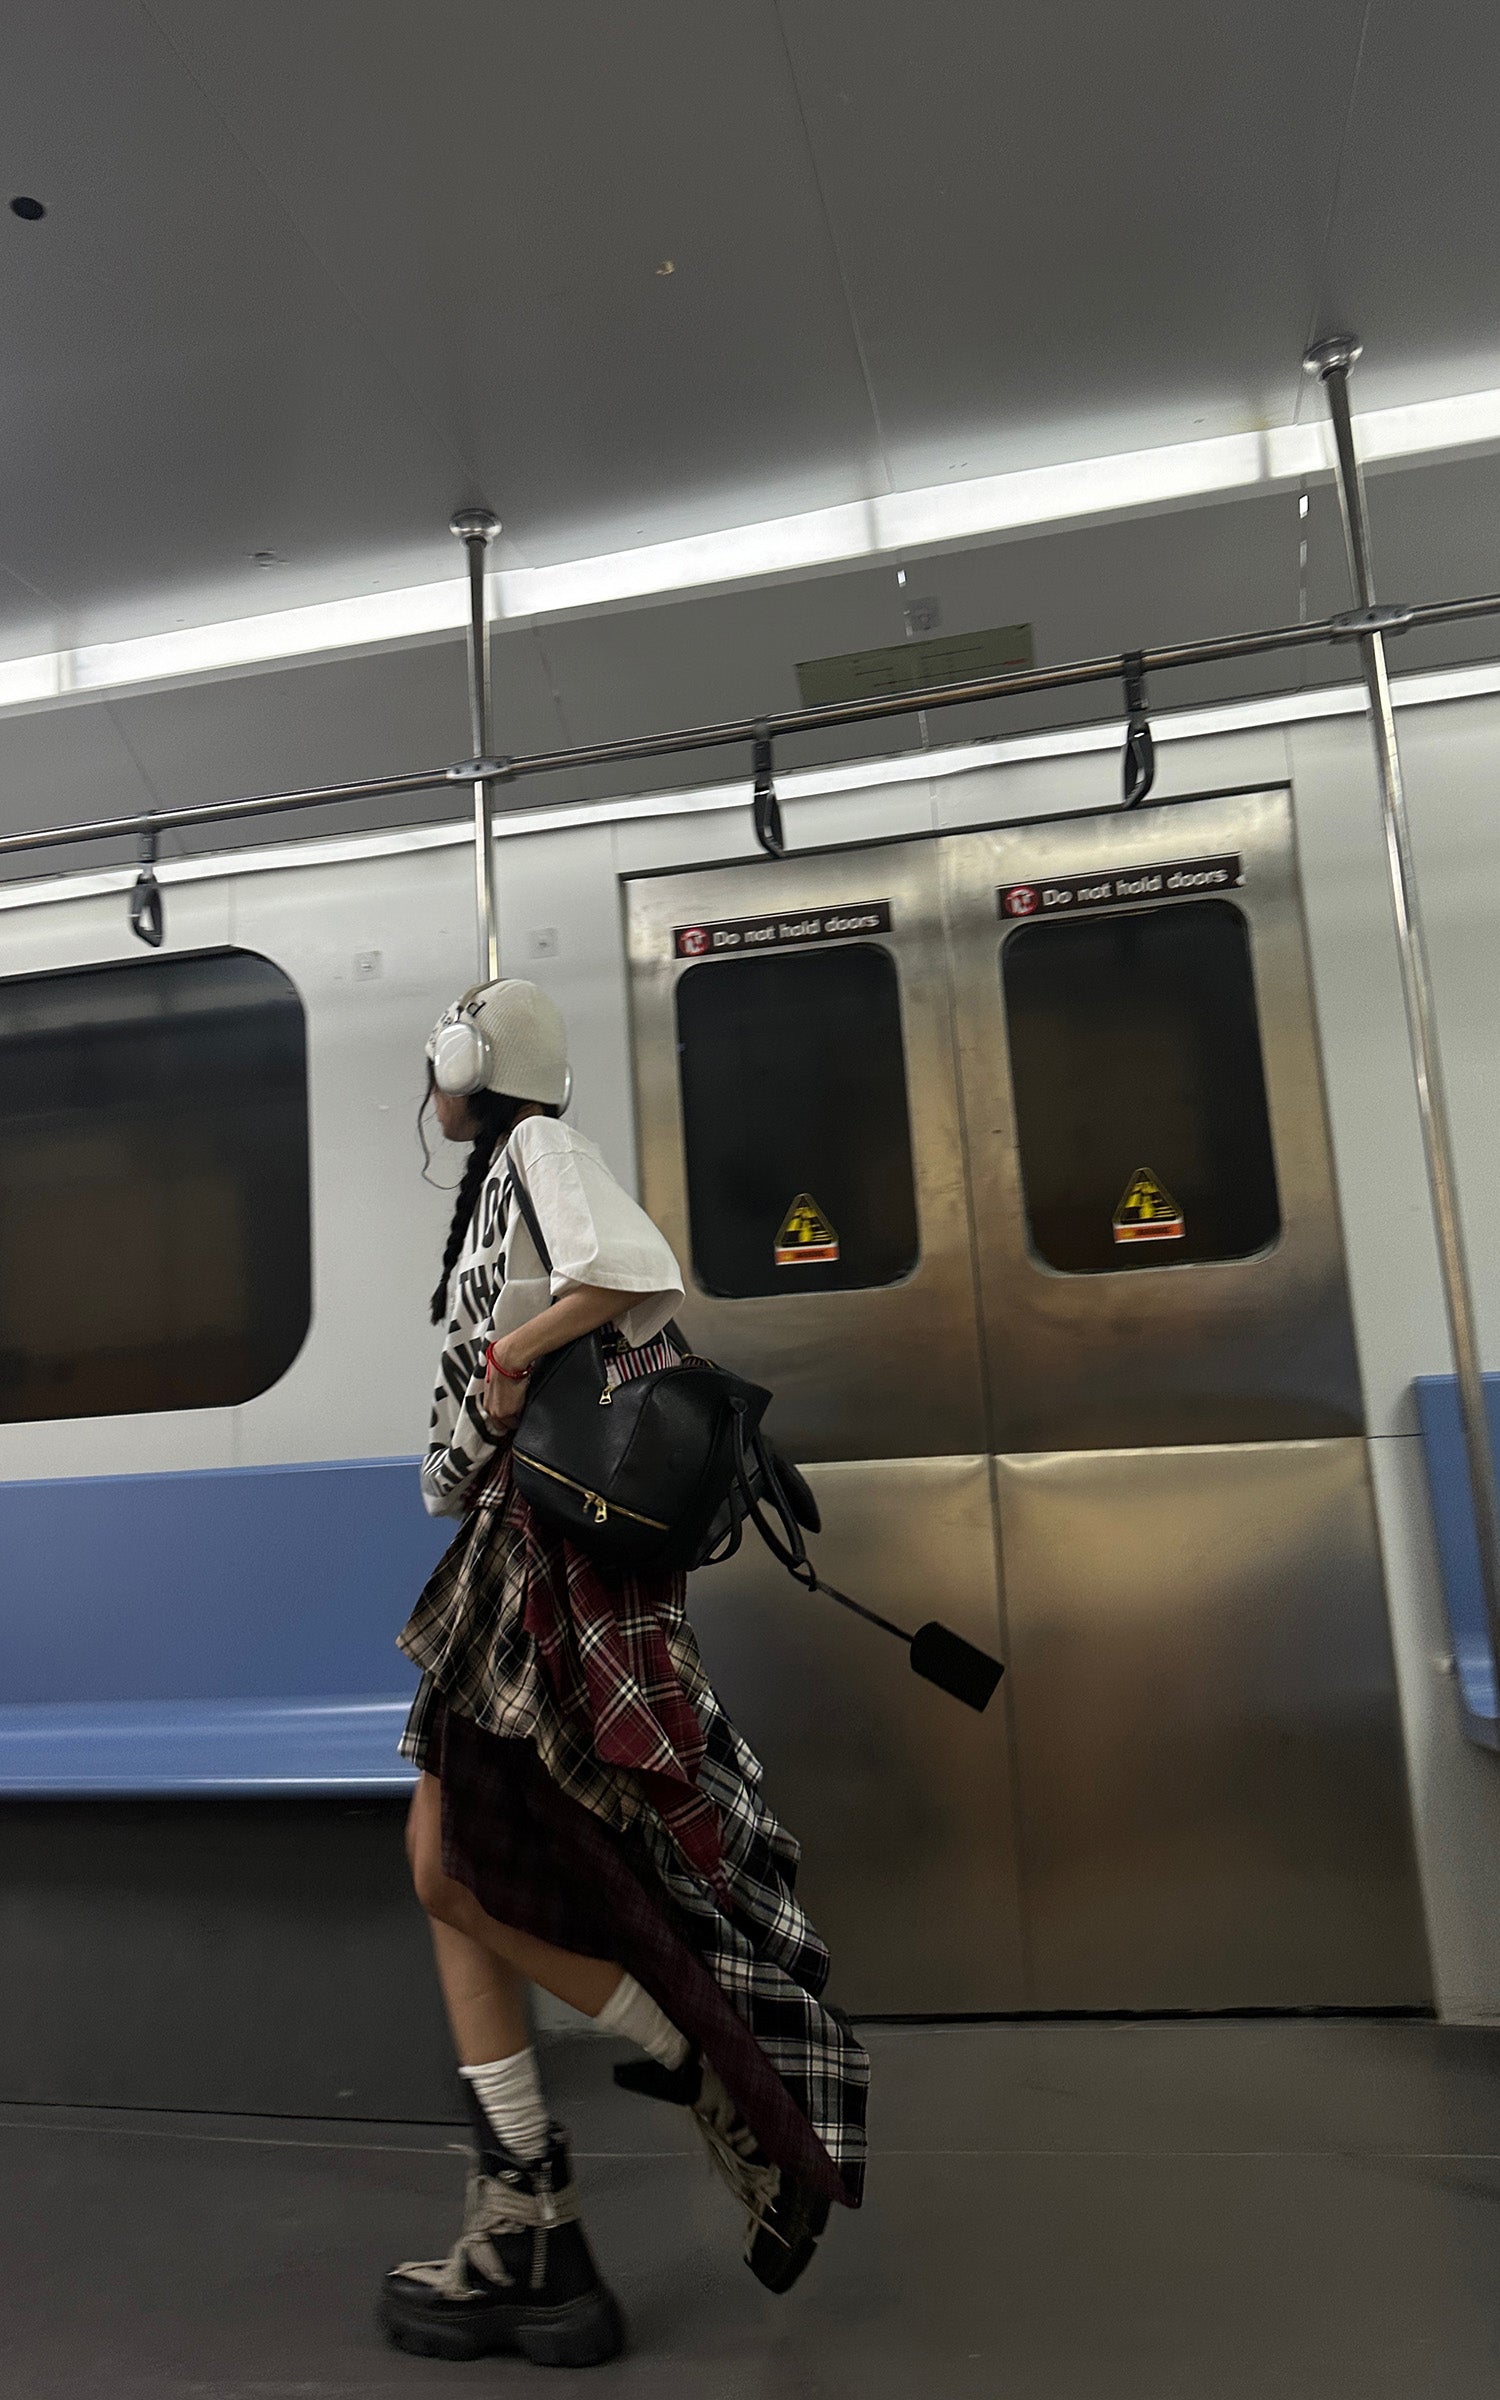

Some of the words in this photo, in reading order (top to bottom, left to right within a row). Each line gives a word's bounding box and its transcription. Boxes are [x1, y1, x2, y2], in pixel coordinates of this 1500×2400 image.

[1042, 889, 1073, 906] Do
[1077, 881, 1113, 901] not
[1116, 874, 1163, 896] hold
[1166, 867, 1229, 889] doors
[713, 931, 741, 947] Do
[744, 925, 775, 944] not
[779, 919, 821, 939] hold
[824, 913, 880, 933] doors
